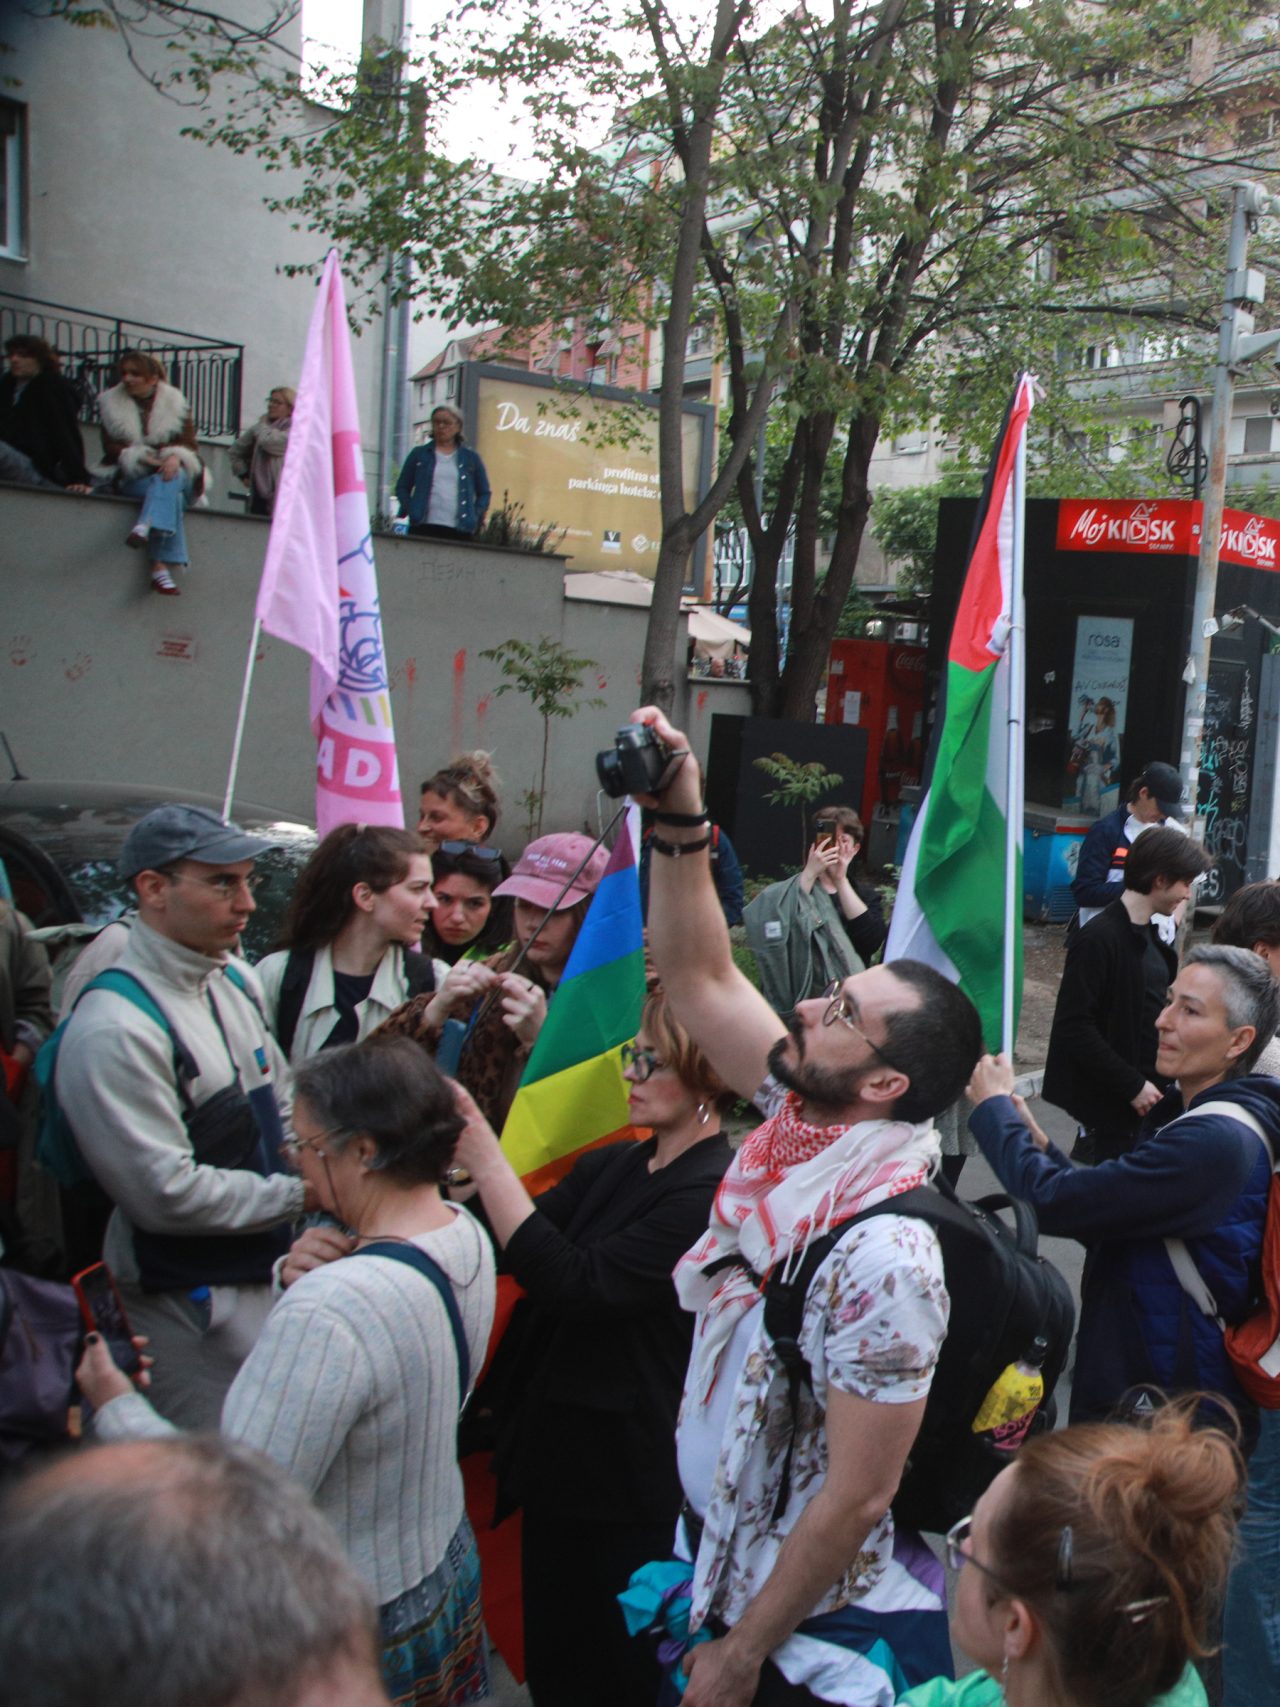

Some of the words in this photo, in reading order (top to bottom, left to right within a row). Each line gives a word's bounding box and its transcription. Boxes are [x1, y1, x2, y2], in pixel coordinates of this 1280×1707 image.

[495, 401, 530, 435] Da
[534, 417, 581, 442] znaš
[1087, 633, 1121, 648] rosa
